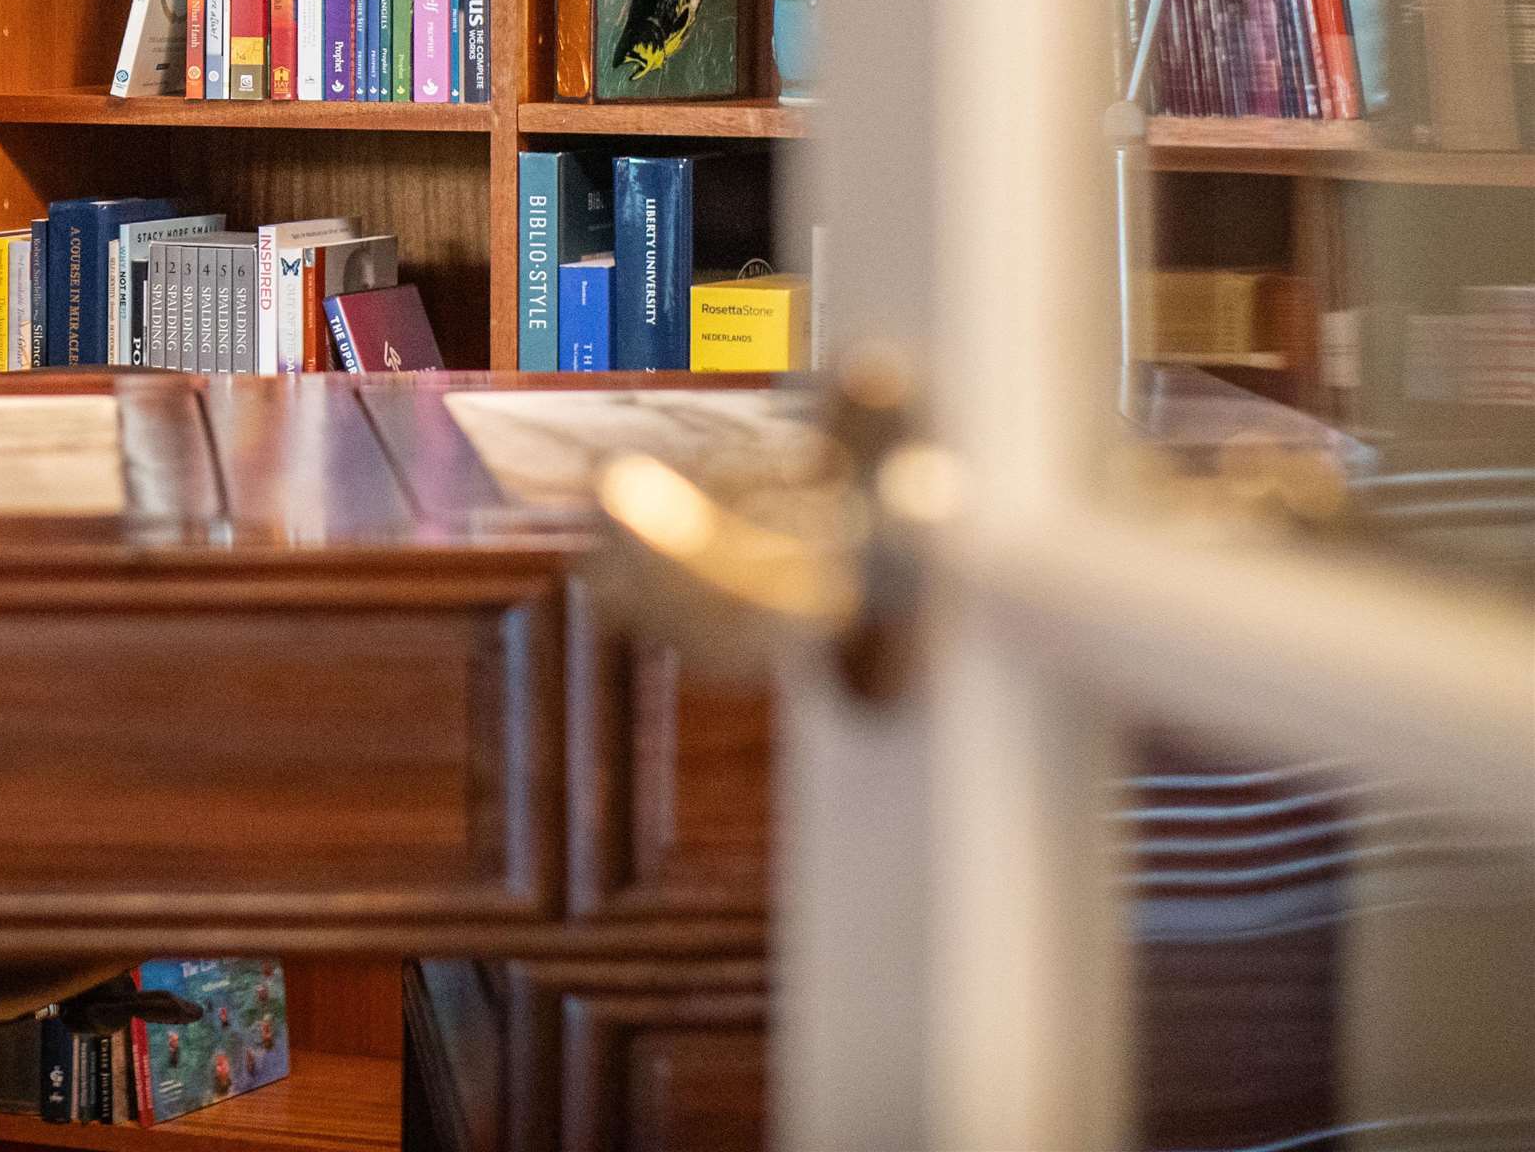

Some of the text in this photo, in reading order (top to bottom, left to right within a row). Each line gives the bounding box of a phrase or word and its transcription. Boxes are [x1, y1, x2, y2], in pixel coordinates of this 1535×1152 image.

[191, 1, 202, 23] Nhat
[191, 24, 202, 48] Hanh
[468, 29, 476, 60] WORKS
[332, 41, 344, 72] Prophet
[476, 29, 484, 90] THE COMPLETE
[119, 246, 127, 291] WHY NOT
[137, 231, 164, 244] STACY
[645, 198, 656, 325] LIBERTY UNIVERSITY
[32, 238, 43, 367] Robert Silence
[69, 226, 81, 368] A COURSE IN MIRACLES
[151, 261, 163, 351] 1 SPALDING
[167, 261, 177, 352] 2 SPALDING
[260, 234, 272, 311] INSPIRED
[182, 263, 194, 353] 3 SPALDING
[201, 263, 211, 354] 4 SPALDING
[218, 264, 229, 355] 5 SPALDING
[235, 265, 247, 355] 6 SPALDING
[329, 315, 346, 341] THE
[701, 303, 775, 317] RosettaStone
[701, 332, 753, 343] NEDERLANDS
